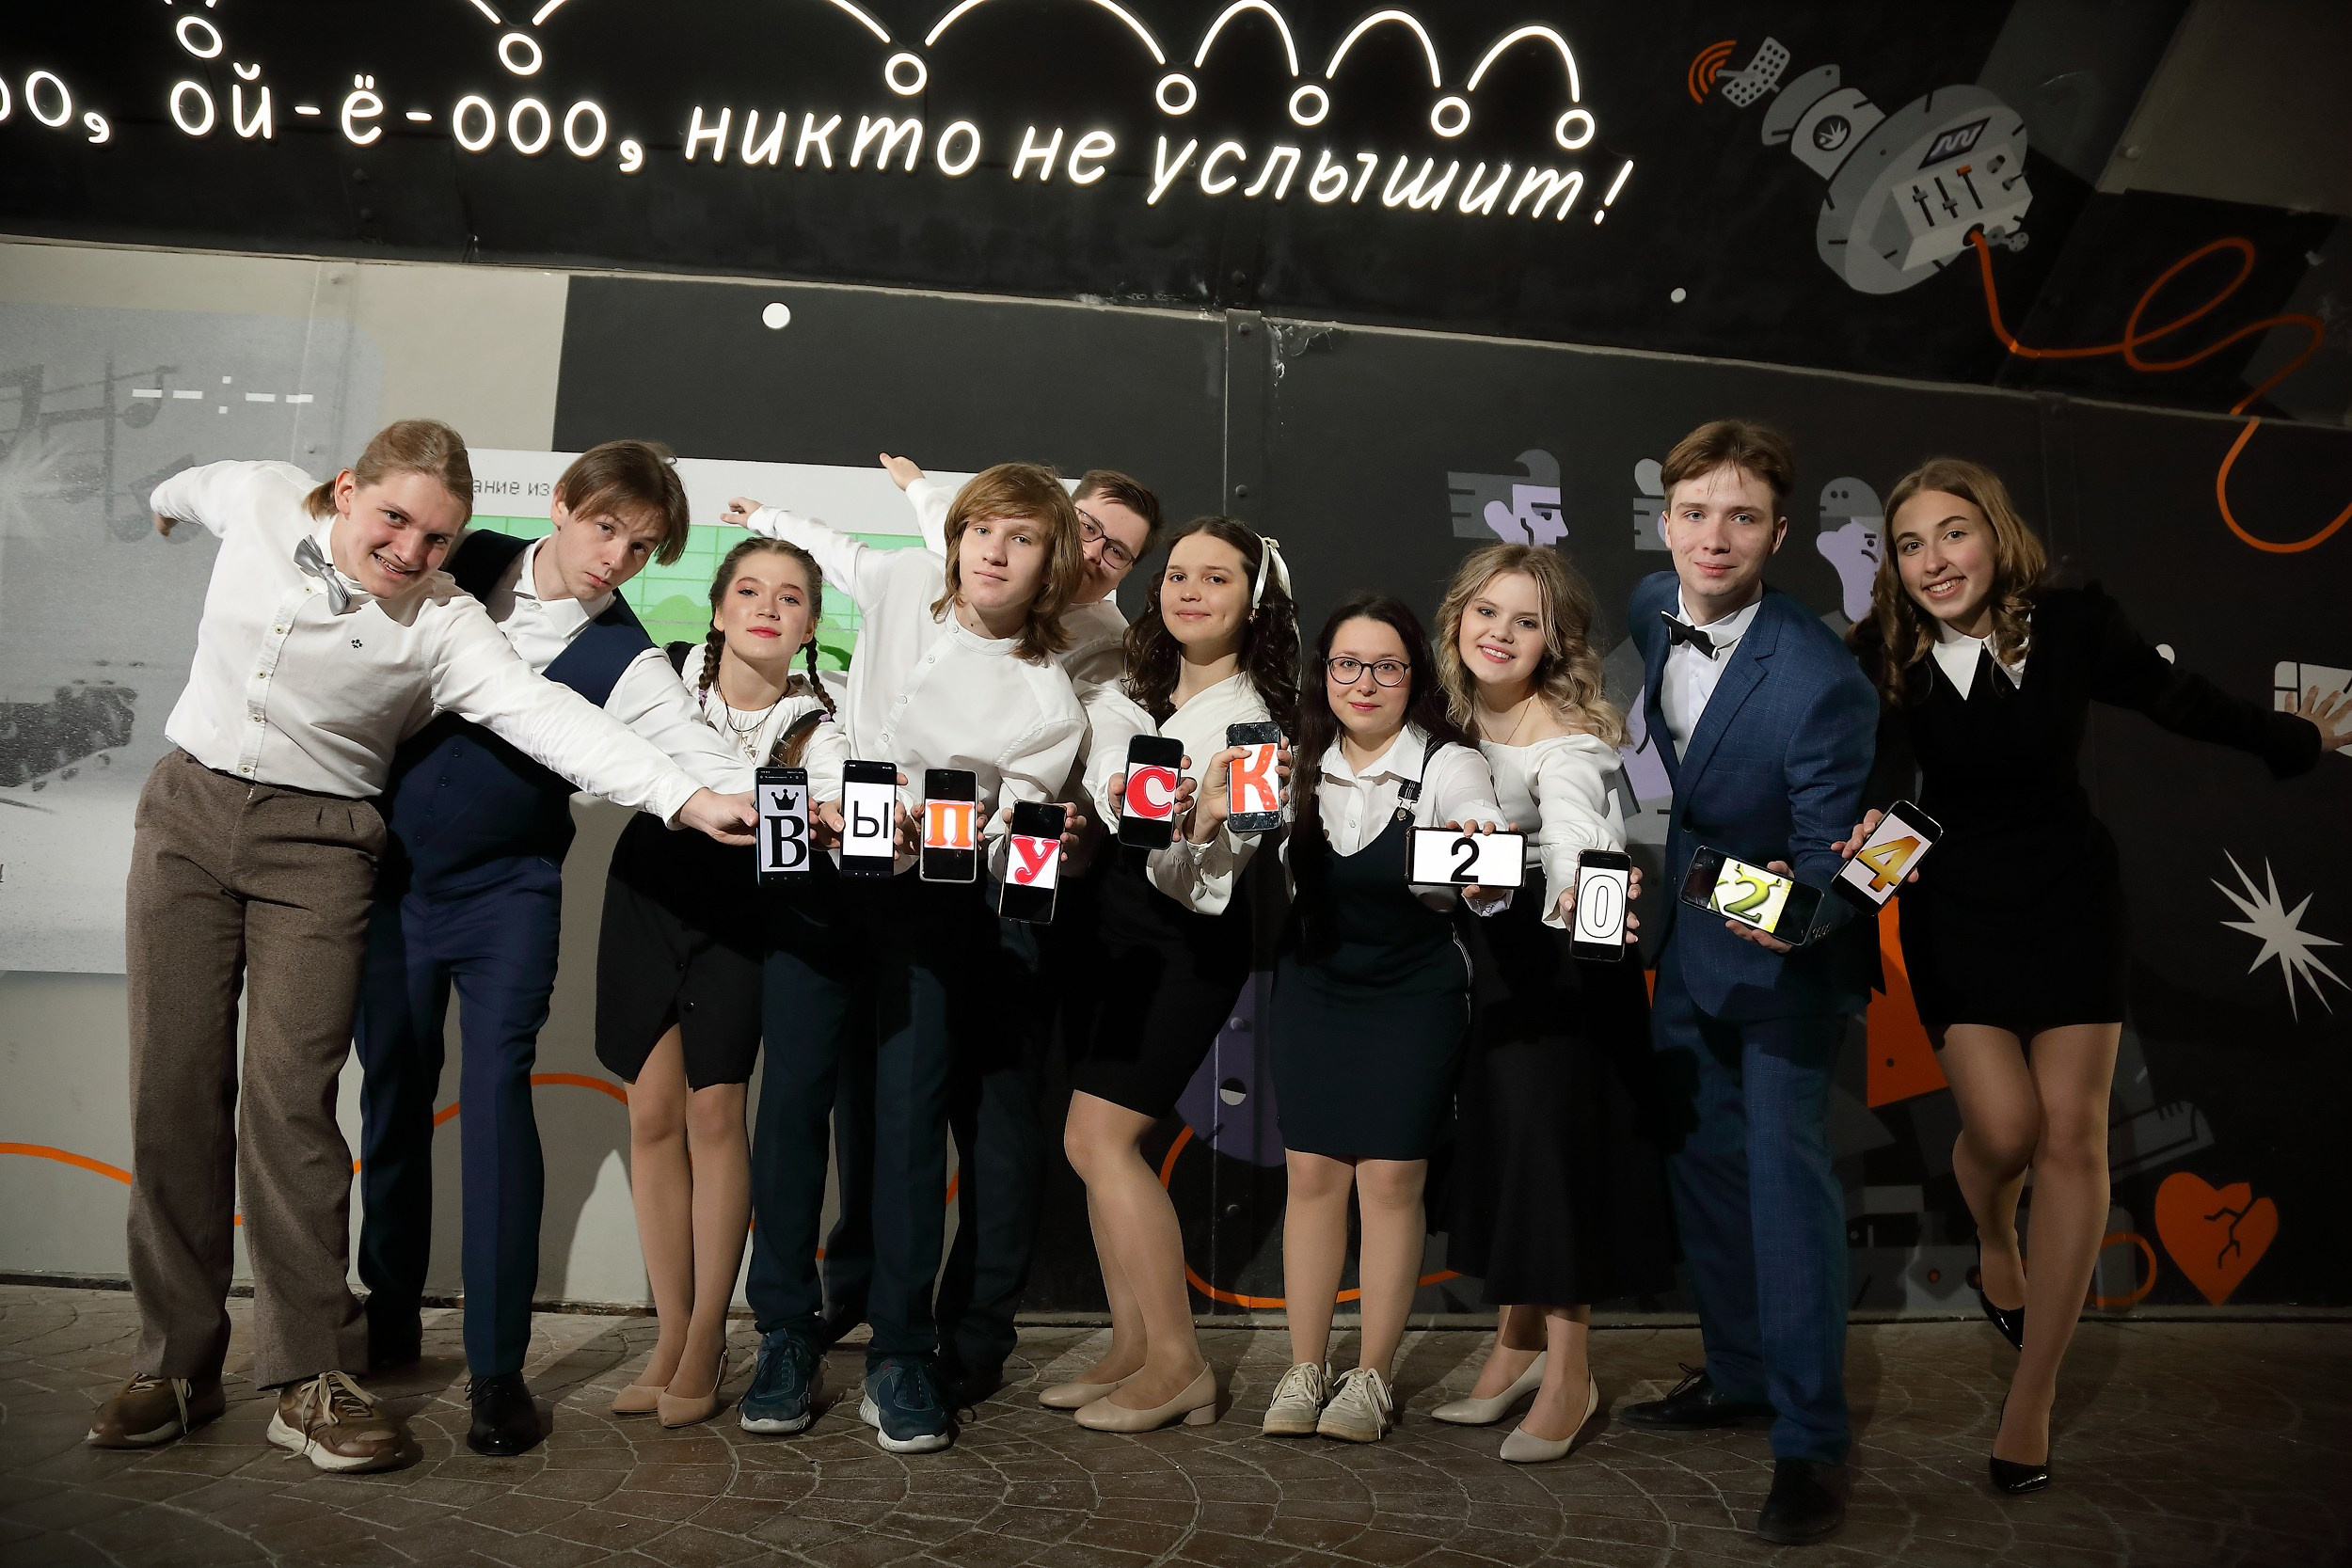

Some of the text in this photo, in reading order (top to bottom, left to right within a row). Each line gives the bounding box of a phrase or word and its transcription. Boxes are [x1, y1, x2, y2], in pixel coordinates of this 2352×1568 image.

[0, 71, 110, 144] о,
[685, 105, 981, 176] никто
[1011, 125, 1116, 184] не
[1146, 135, 1634, 225] услышит!
[1450, 836, 1480, 883] 2
[1855, 835, 1921, 893] 4
[1580, 874, 1625, 939] 0
[1723, 863, 1782, 925] 2
